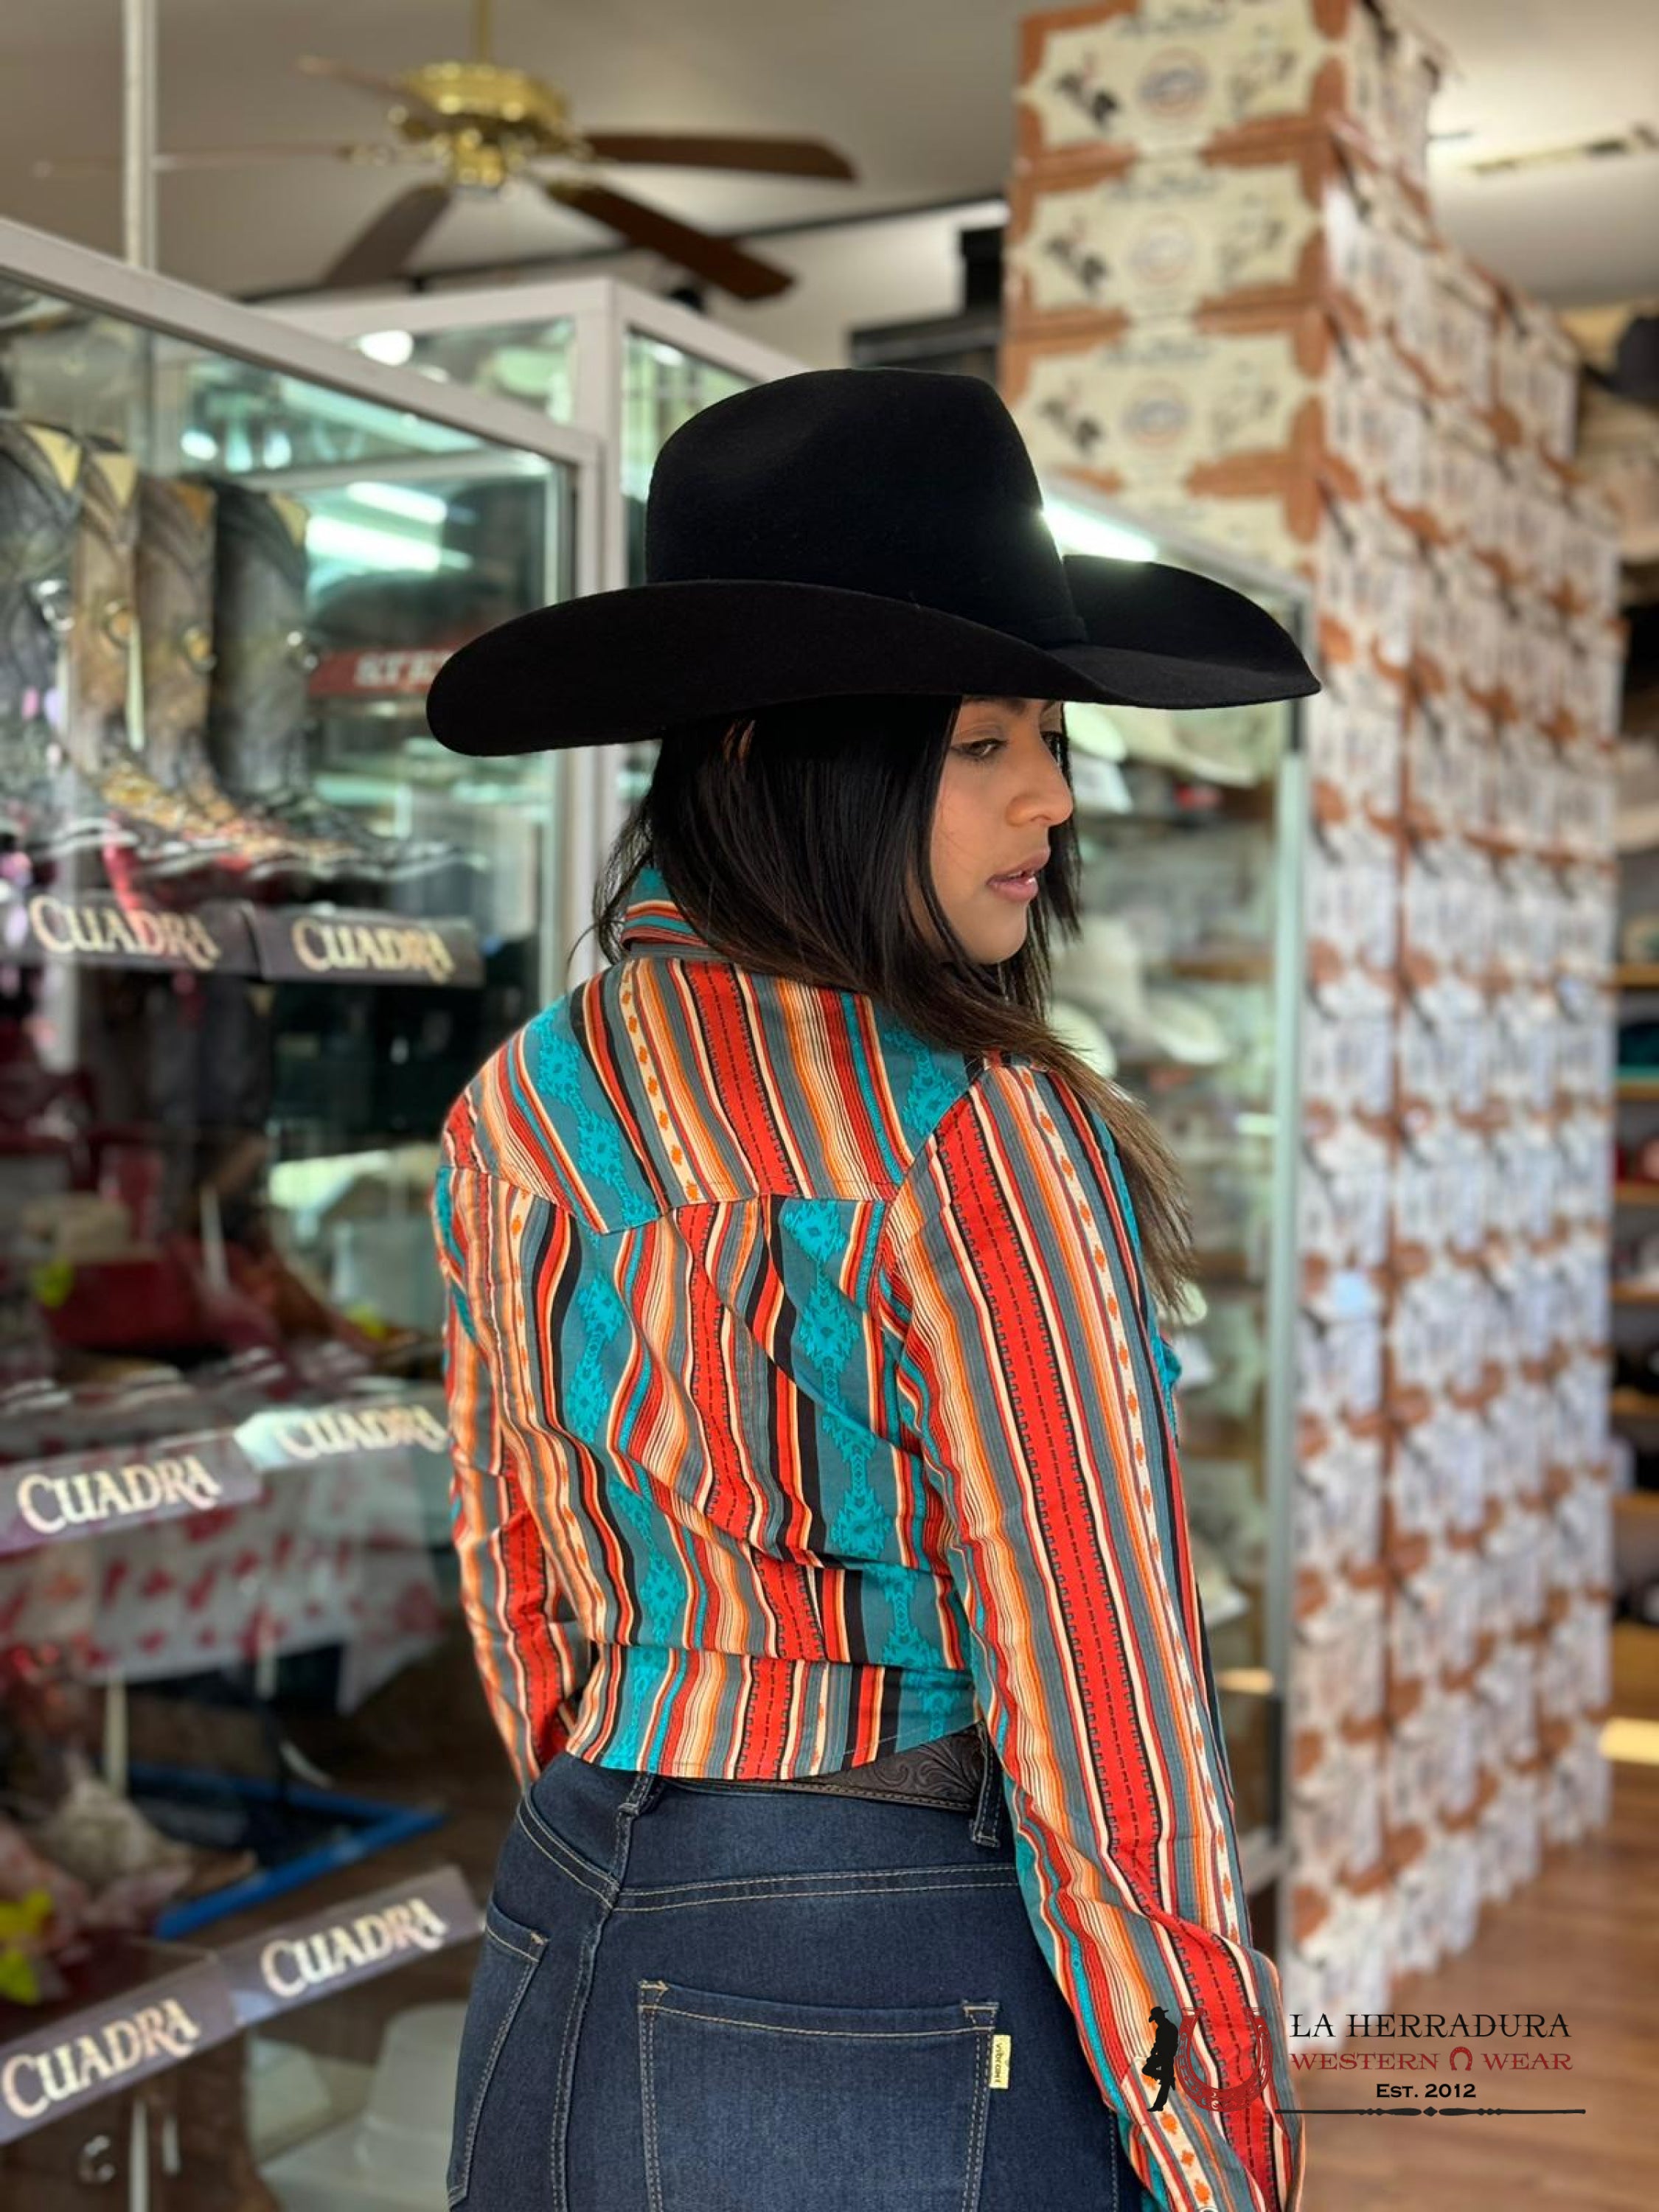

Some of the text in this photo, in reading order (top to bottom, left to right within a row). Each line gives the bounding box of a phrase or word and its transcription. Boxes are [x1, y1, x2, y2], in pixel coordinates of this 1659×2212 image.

[29, 894, 219, 970] CUADRA
[292, 917, 456, 984] CUADRA
[273, 1404, 449, 1460] CUADRA
[17, 1454, 222, 1534] CUADRA
[260, 1897, 448, 1998] CUADRA
[1, 1998, 201, 2119] CUADRA
